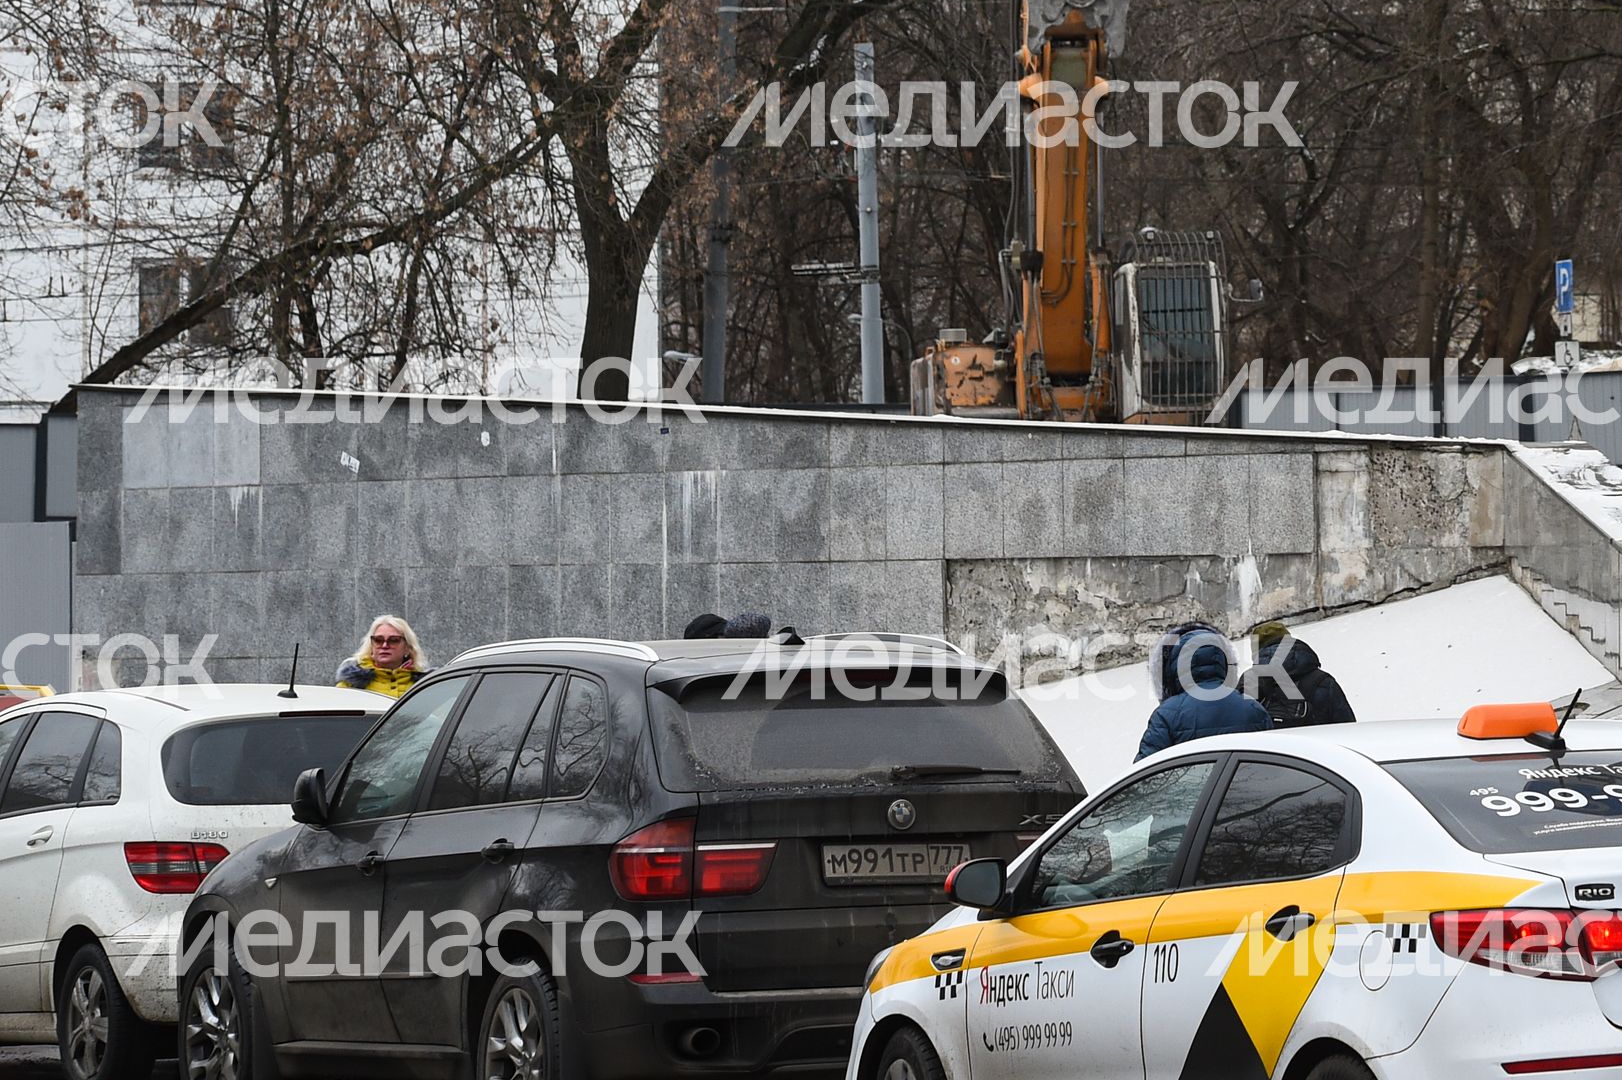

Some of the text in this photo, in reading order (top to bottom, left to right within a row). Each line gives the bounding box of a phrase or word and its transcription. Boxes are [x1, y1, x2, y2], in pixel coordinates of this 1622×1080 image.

[1561, 268, 1569, 306] P
[1519, 763, 1601, 780] Яндекс
[1469, 786, 1499, 797] 495
[831, 845, 964, 874] М991ТР 777
[1578, 886, 1611, 898] RIO
[1154, 943, 1179, 984] 110
[980, 961, 1074, 1007] Яндекс Такси
[994, 1021, 1073, 1052] (495) 999 99 99
